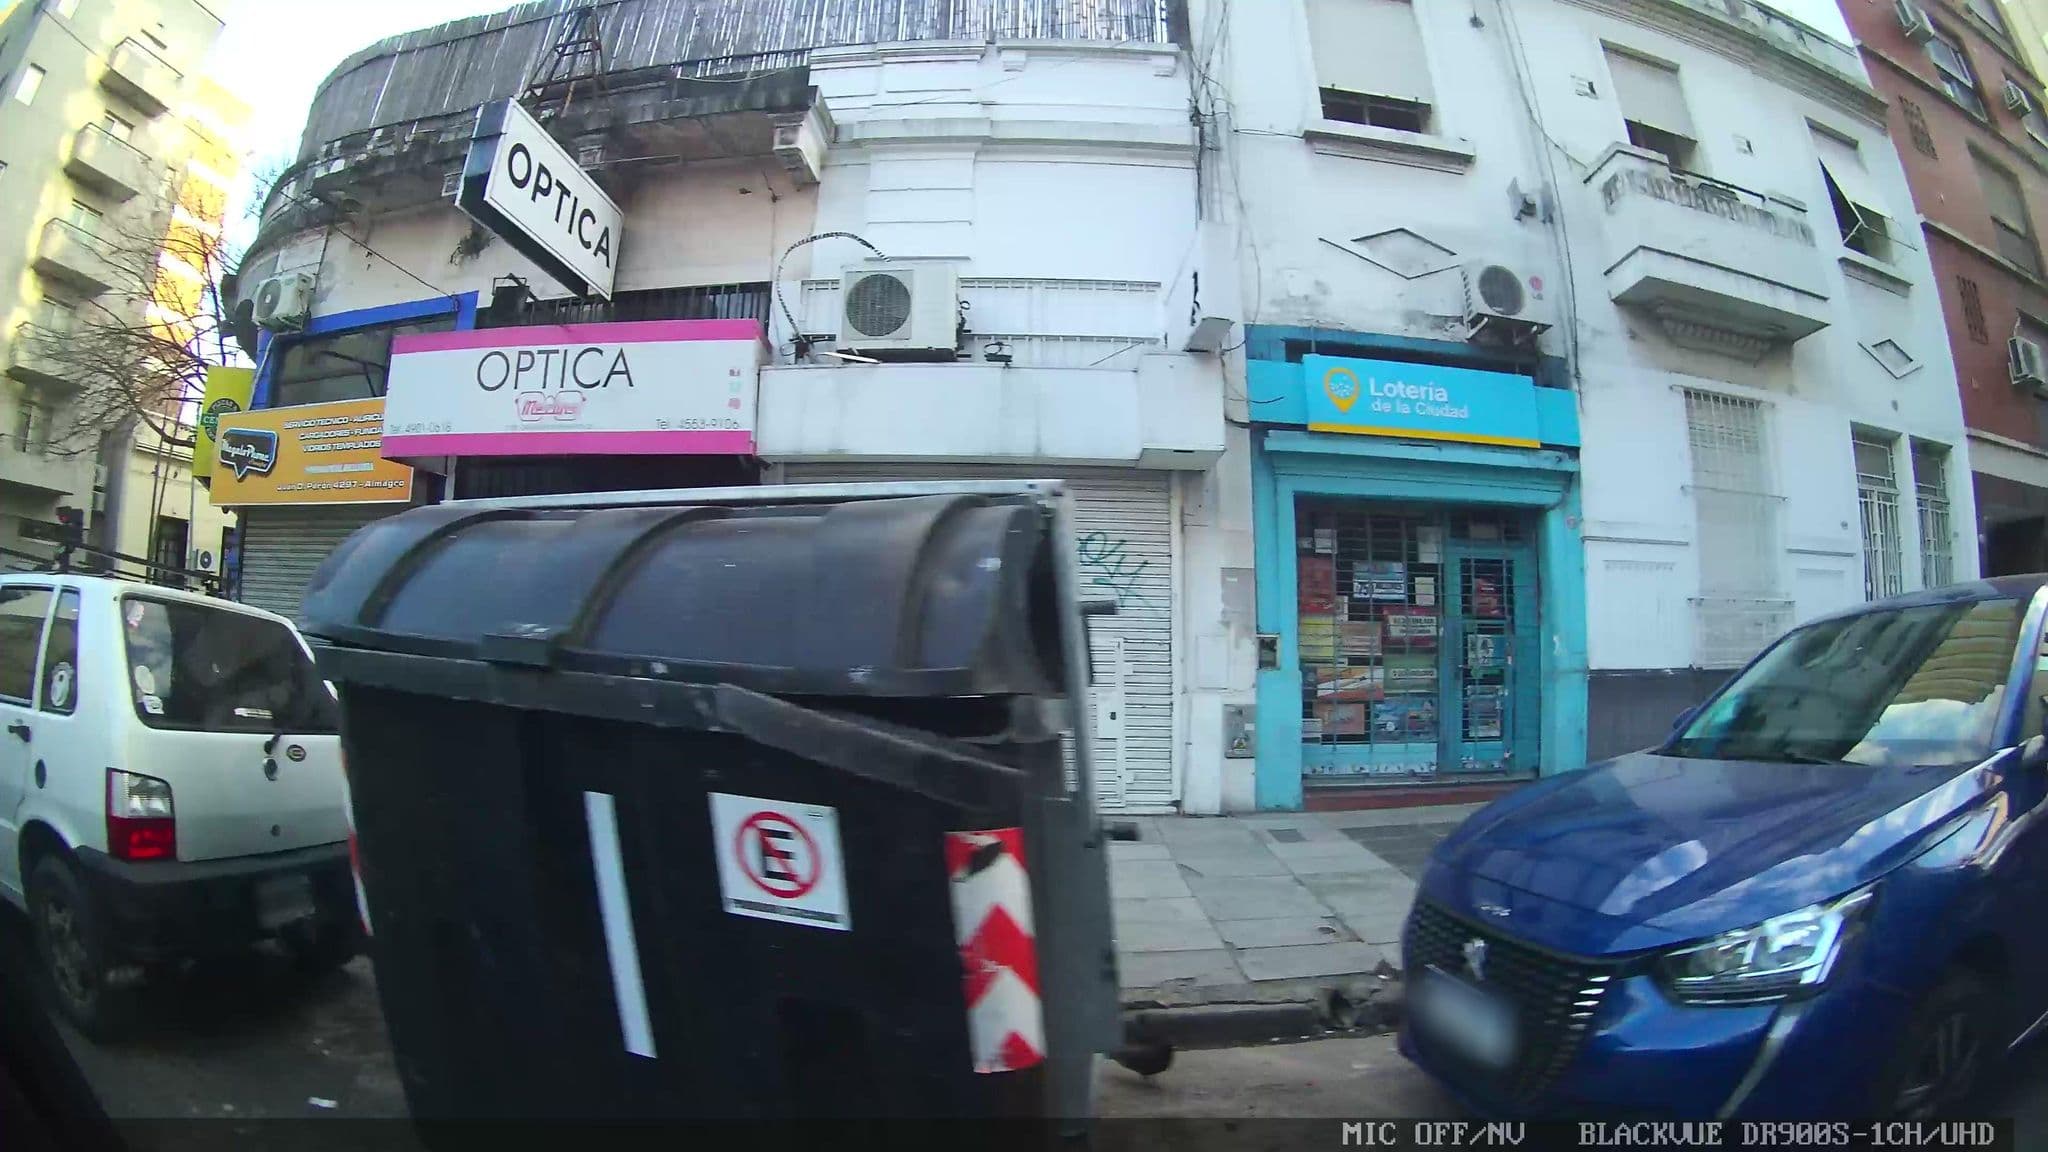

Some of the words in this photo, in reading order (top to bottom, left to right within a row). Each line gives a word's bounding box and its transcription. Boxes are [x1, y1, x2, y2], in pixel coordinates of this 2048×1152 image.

[508, 143, 610, 268] OPTICA
[477, 347, 634, 391] OPTICA
[1369, 377, 1448, 401] Lotería
[1372, 398, 1391, 412] de
[1396, 399, 1410, 414] la
[1416, 401, 1469, 418] Ciudad
[333, 480, 357, 489] 4297
[758, 828, 799, 882] E
